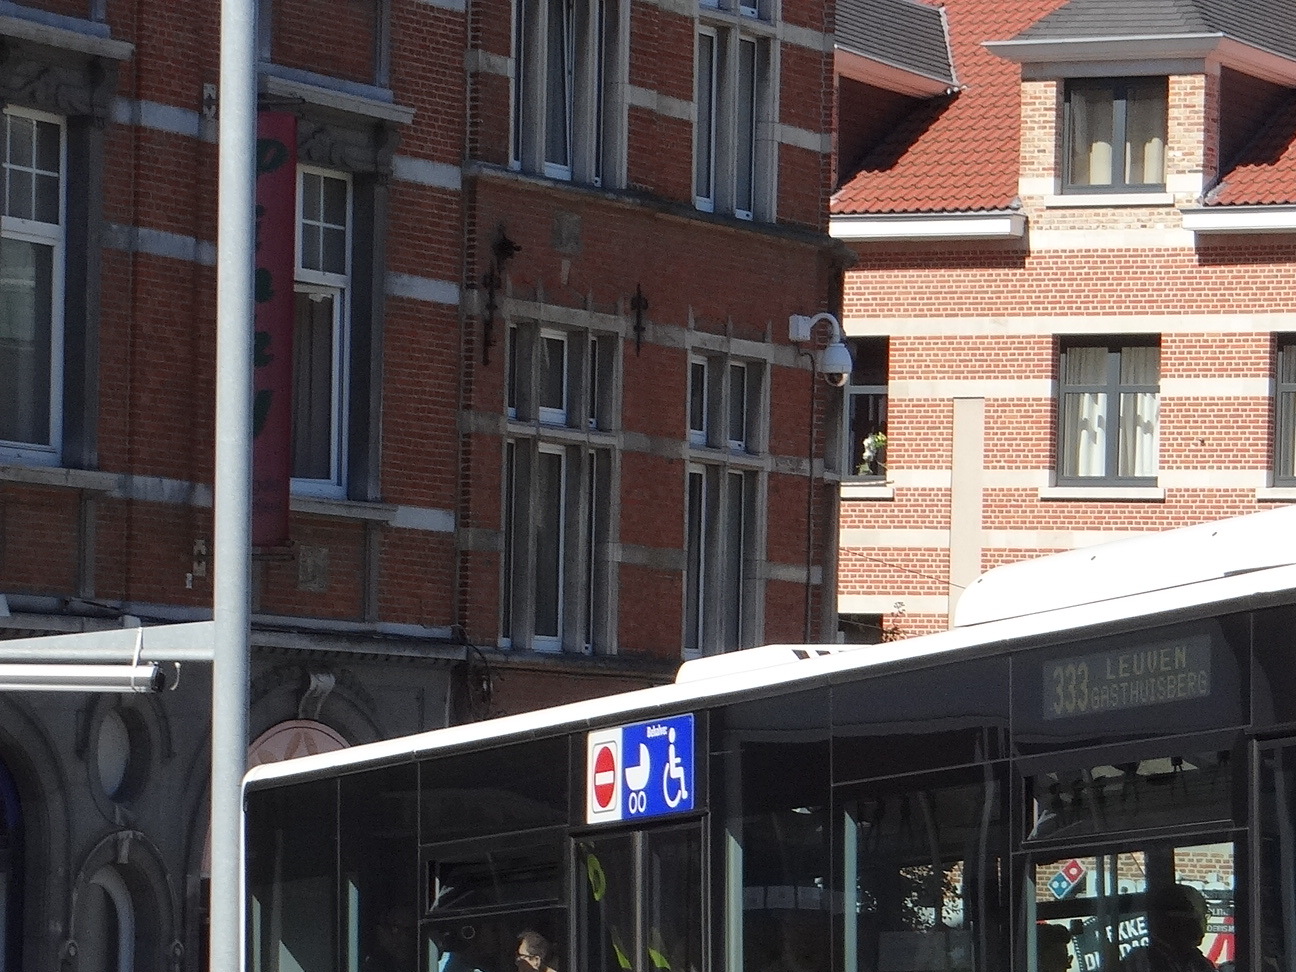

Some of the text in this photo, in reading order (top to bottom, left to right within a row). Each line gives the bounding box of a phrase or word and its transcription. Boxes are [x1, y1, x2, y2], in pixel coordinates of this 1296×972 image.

[1106, 646, 1187, 680] LEUVEN
[1053, 662, 1088, 715] 333
[1091, 670, 1209, 709] GASTHUISBERG
